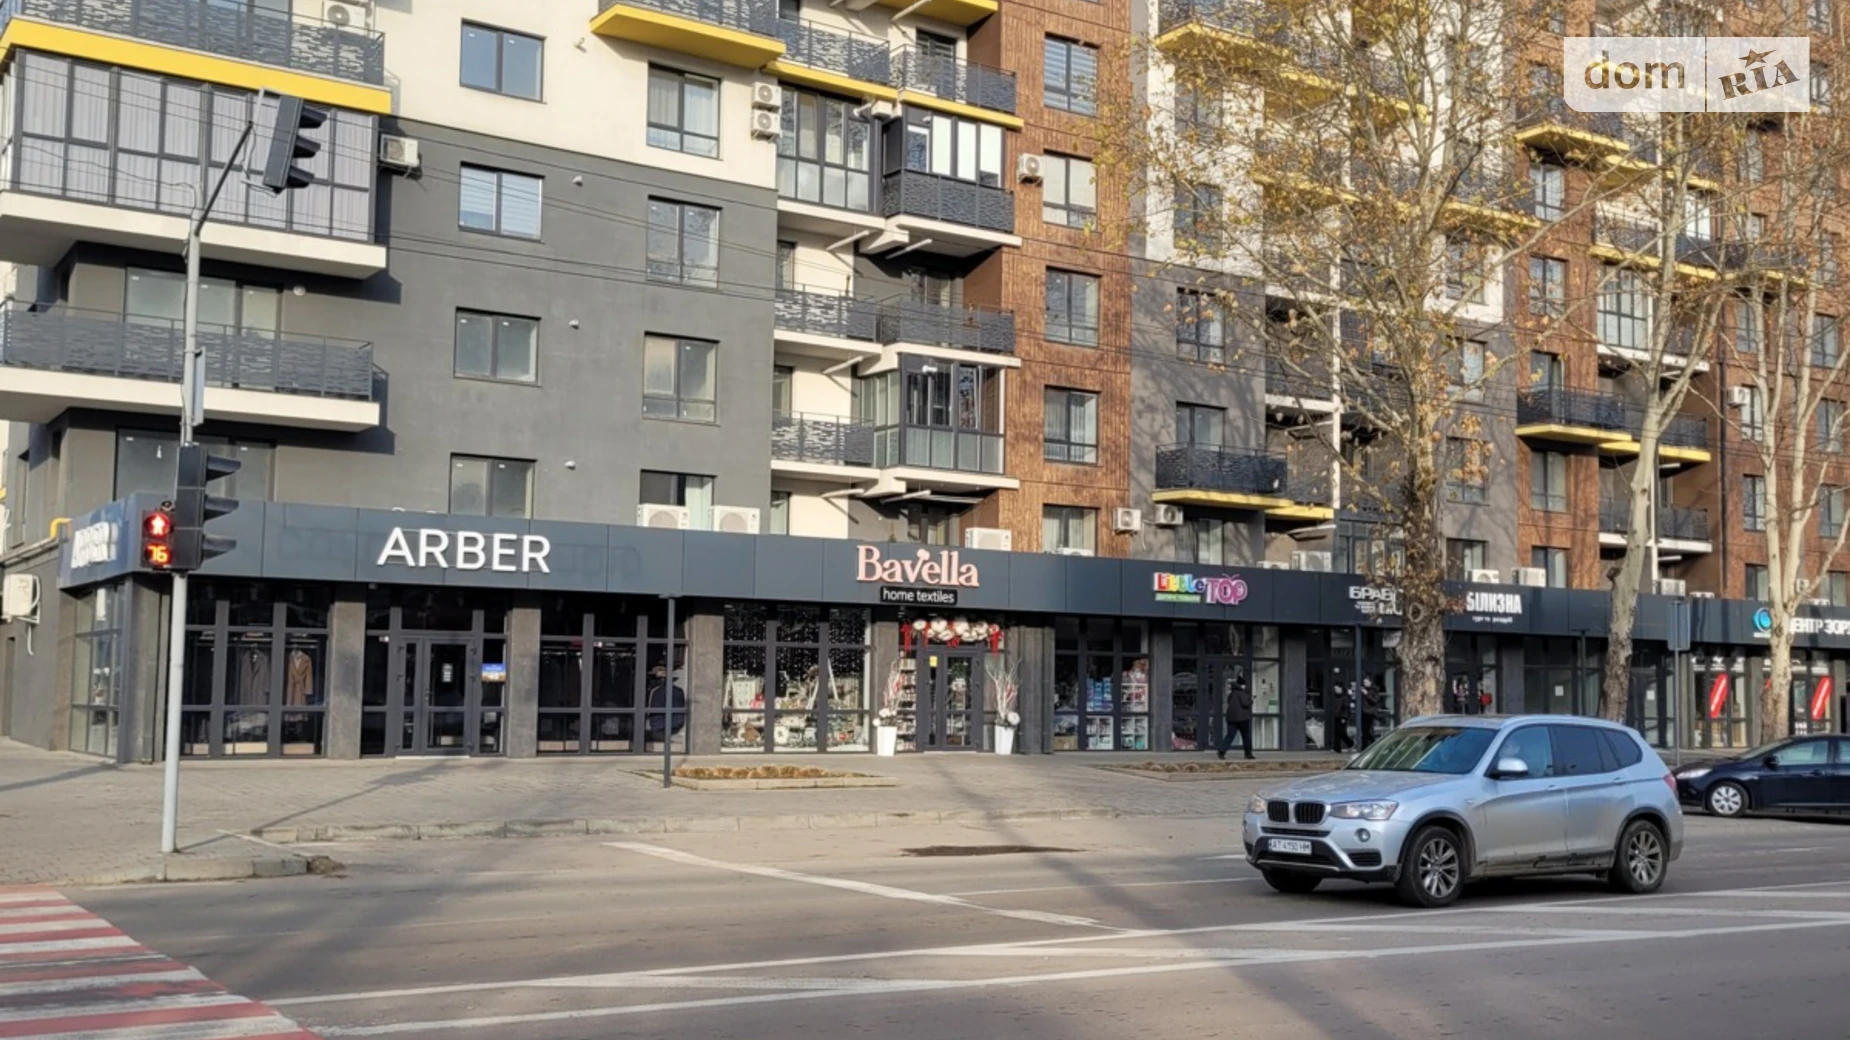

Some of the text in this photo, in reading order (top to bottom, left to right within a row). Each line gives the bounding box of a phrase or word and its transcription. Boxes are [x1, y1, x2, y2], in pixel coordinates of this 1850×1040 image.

[376, 526, 552, 574] ARBER
[856, 545, 980, 587] Bavella
[882, 587, 955, 604] home textiles
[1154, 572, 1206, 593] Little
